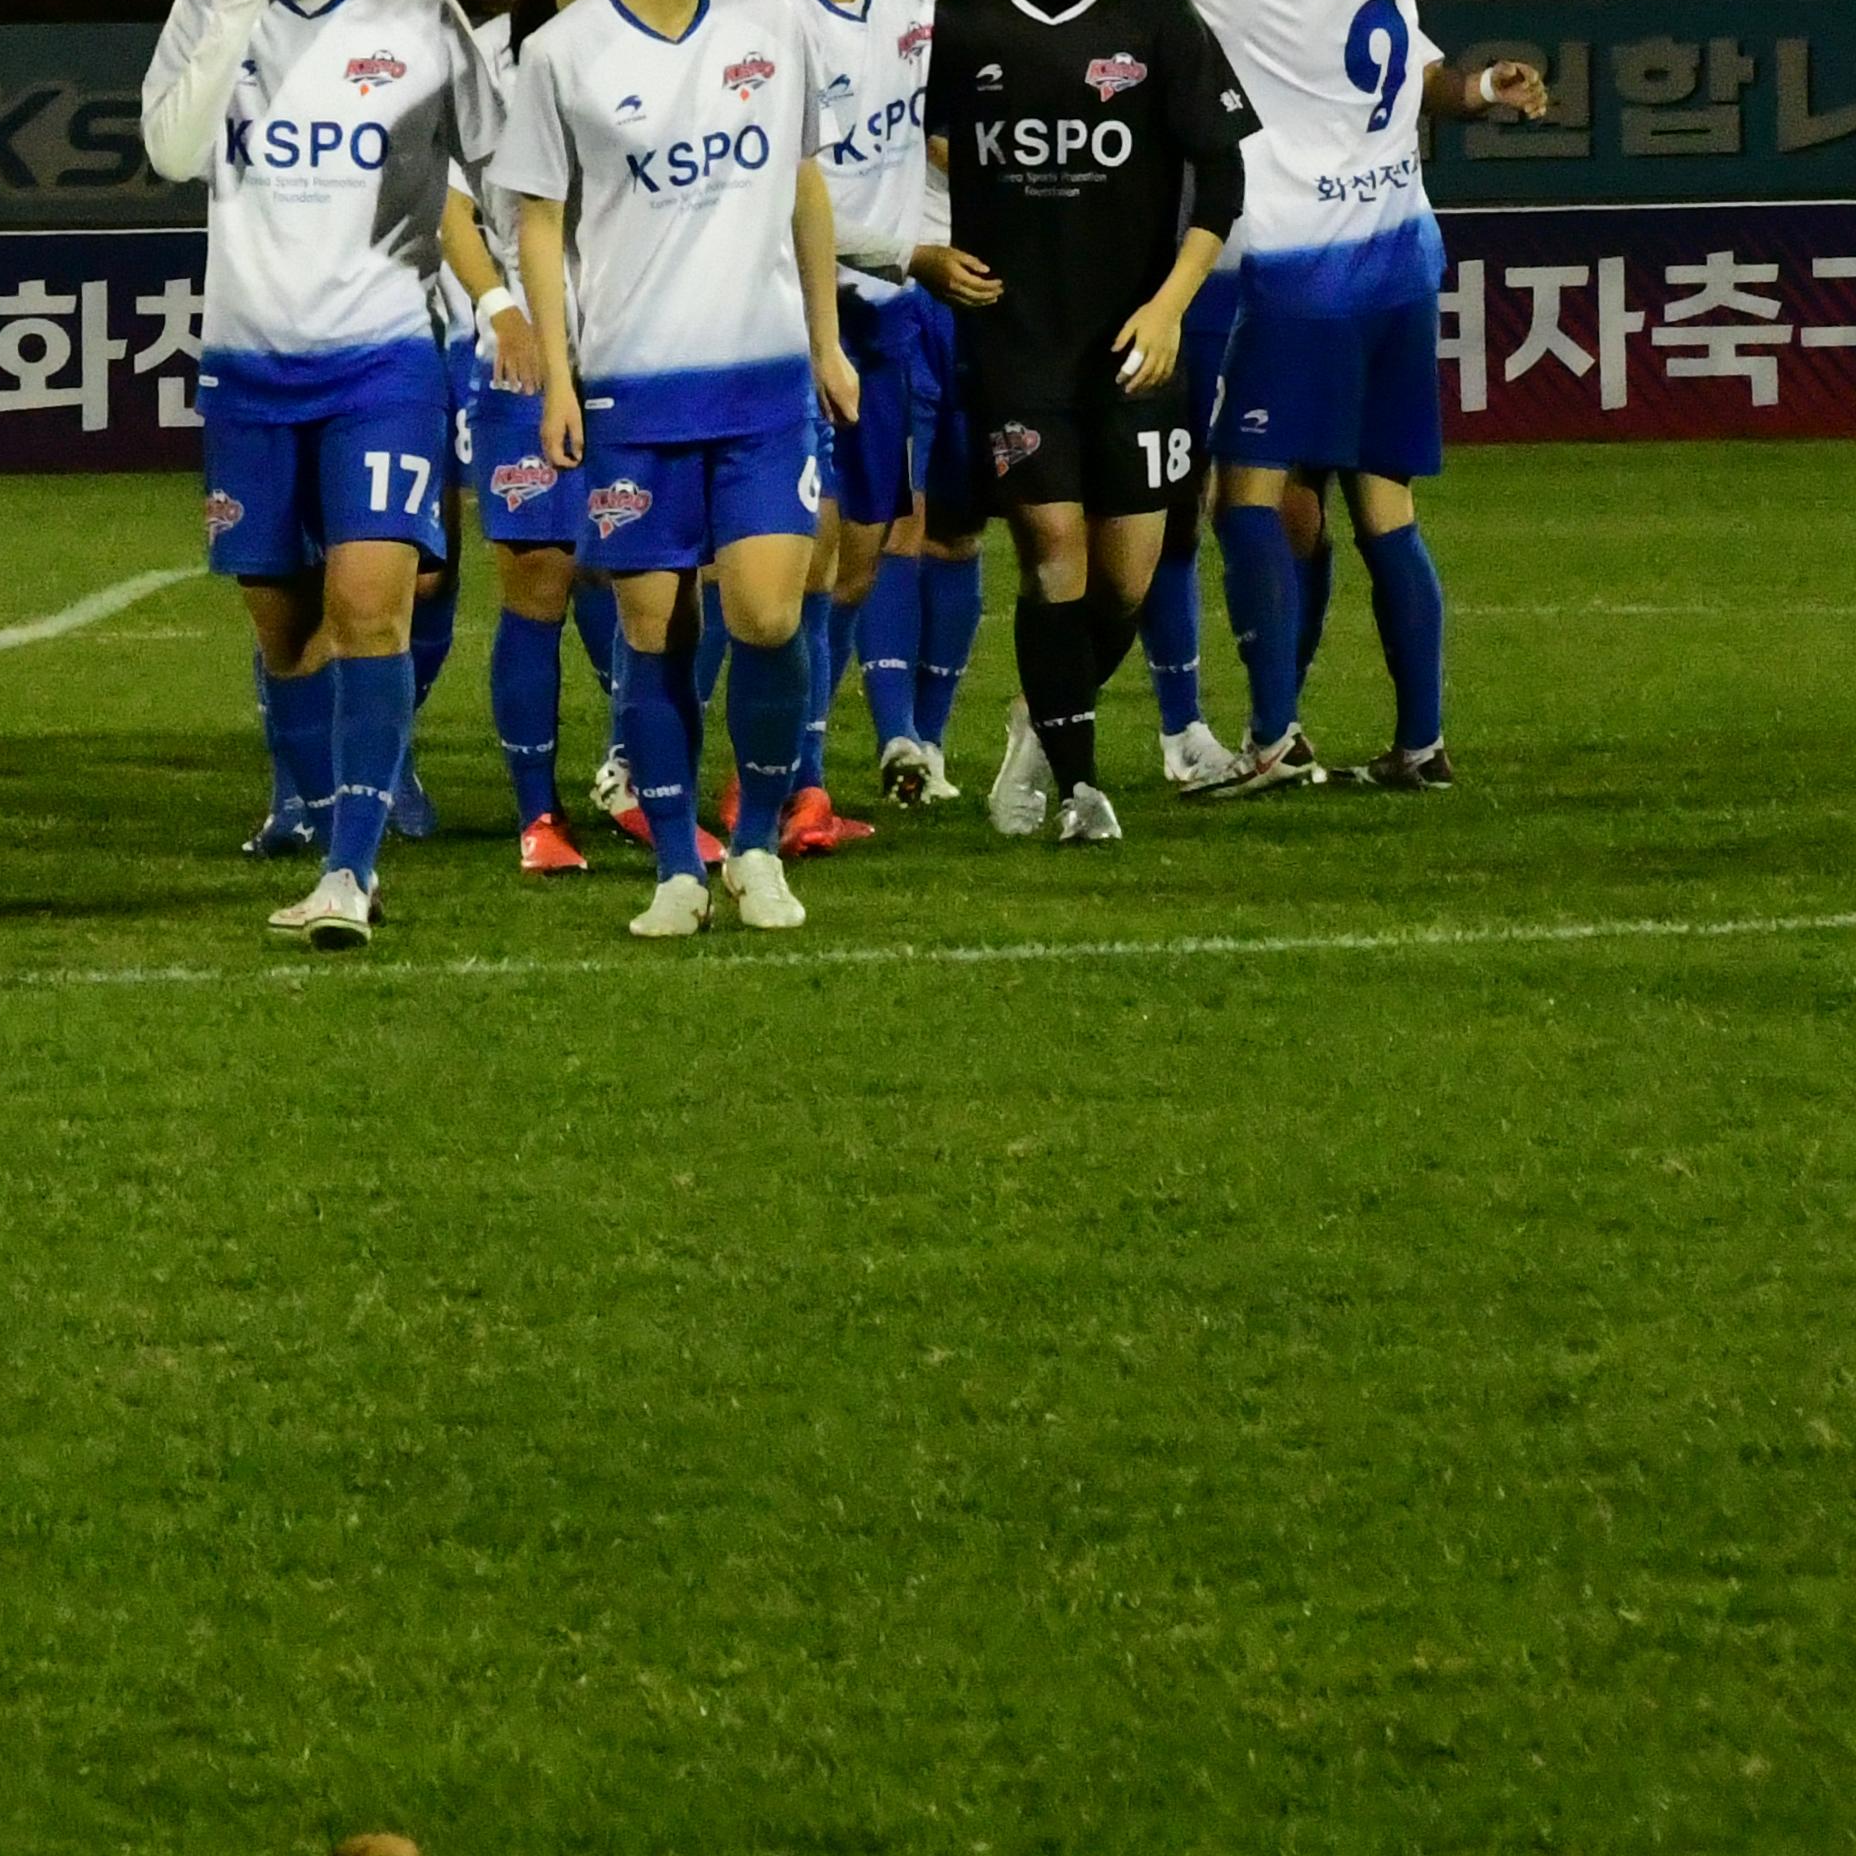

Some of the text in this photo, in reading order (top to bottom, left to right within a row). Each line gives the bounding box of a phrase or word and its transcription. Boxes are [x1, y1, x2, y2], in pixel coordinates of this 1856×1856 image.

[225, 118, 390, 171] KSPO
[626, 124, 770, 193] KSPO
[974, 117, 1134, 168] KSPO
[363, 451, 431, 515] 17
[1137, 427, 1192, 489] 18
